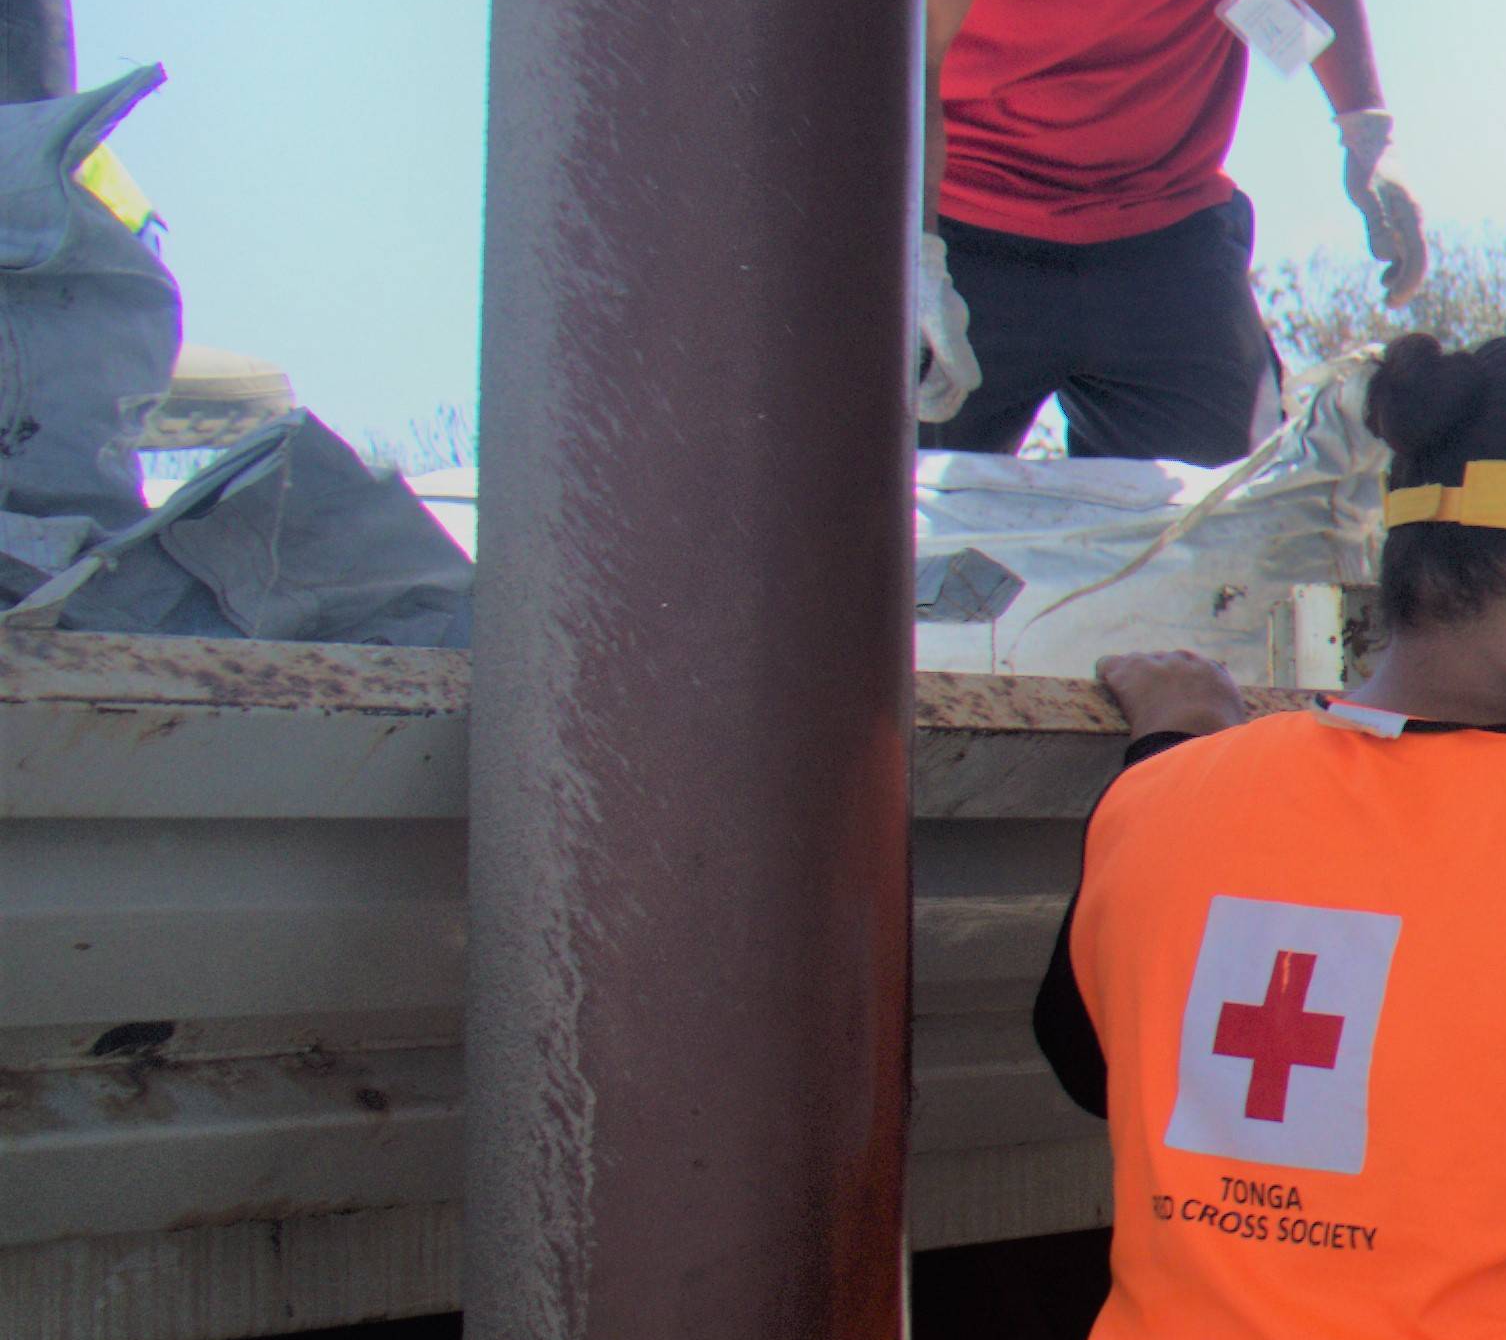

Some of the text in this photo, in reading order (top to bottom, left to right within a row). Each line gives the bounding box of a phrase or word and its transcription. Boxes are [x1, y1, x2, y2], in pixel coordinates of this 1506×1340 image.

[1220, 1176, 1303, 1211] TONGA
[1181, 1198, 1269, 1241] CROSS
[1277, 1216, 1377, 1251] SOCIETY
